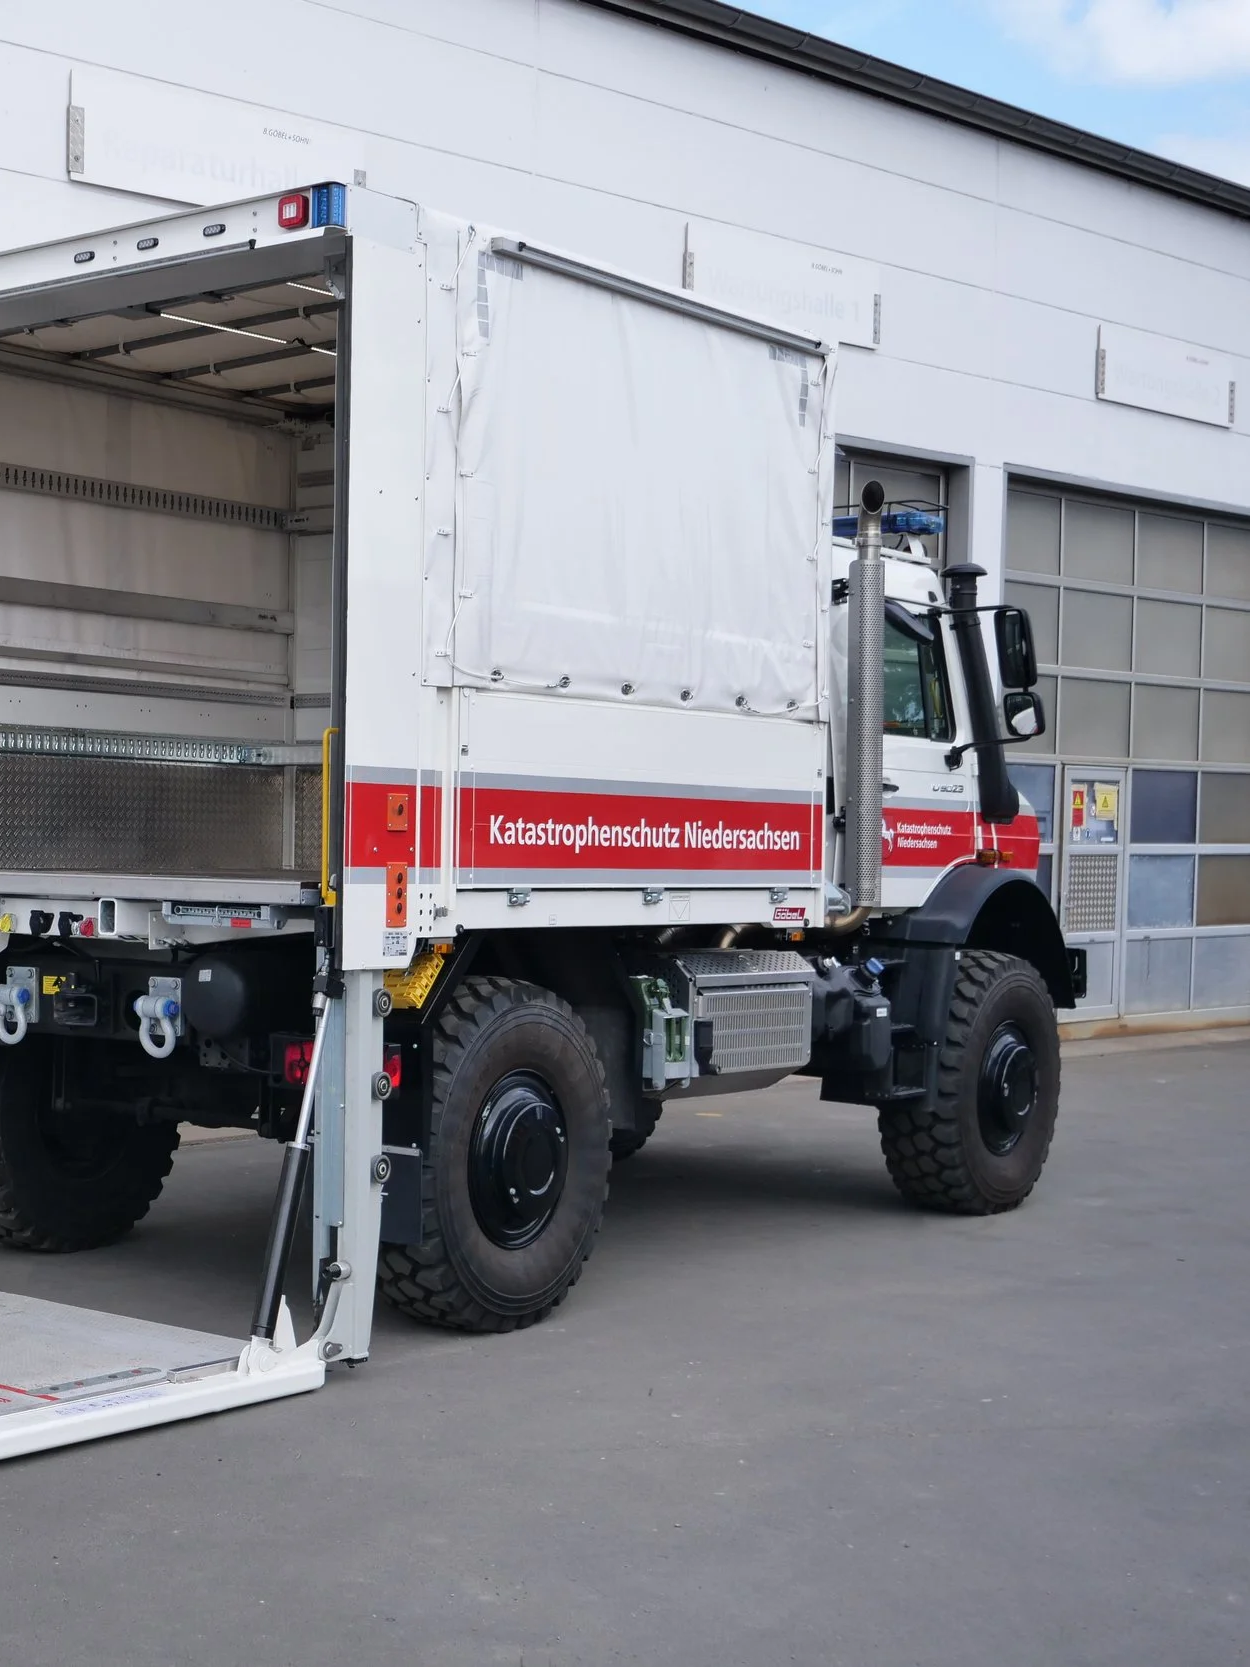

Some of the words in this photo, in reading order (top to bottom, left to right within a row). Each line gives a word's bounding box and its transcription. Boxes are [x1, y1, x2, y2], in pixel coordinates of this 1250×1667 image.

[489, 814, 681, 854] Katastrophenschutz
[684, 820, 800, 852] Niedersachsen
[897, 822, 952, 836] Katastrophenschutz
[897, 837, 938, 849] Niedersachsen
